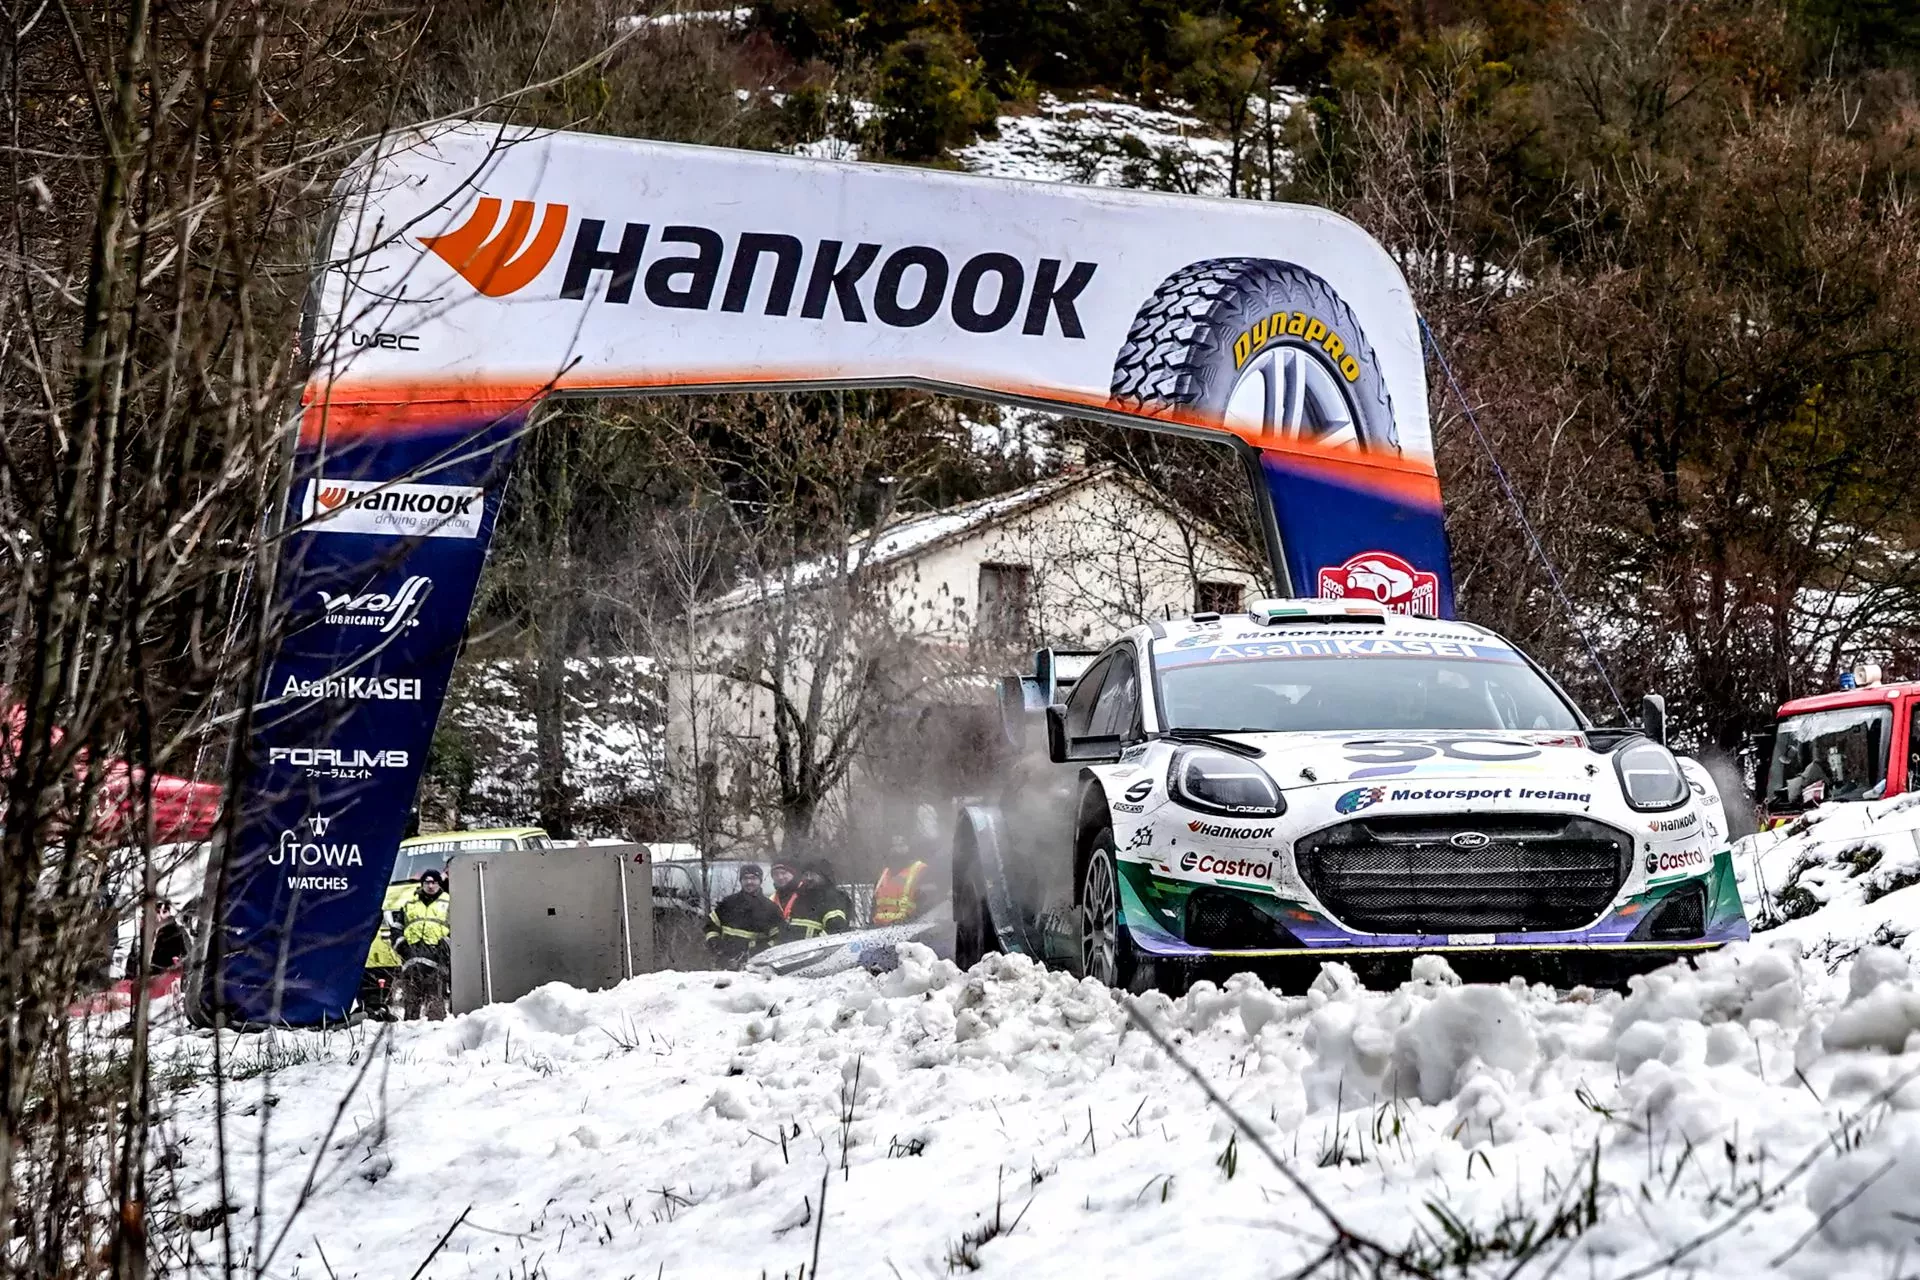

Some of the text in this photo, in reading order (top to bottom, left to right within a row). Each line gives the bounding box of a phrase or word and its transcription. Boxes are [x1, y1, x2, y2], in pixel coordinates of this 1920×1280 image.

[375, 512, 417, 528] driving
[325, 615, 386, 626] LUBRICANTS
[1236, 629, 1485, 642] Motorsport Ireland
[1208, 640, 1478, 660] AsahiKASEI
[269, 747, 409, 768] FORUM8
[1391, 788, 1592, 803] Motorsport Ireland
[268, 829, 363, 866] STOWA
[633, 853, 644, 865] 4
[1660, 846, 1706, 871] Castrol
[1199, 855, 1273, 880] Castrol
[287, 876, 348, 890] WATCHES
